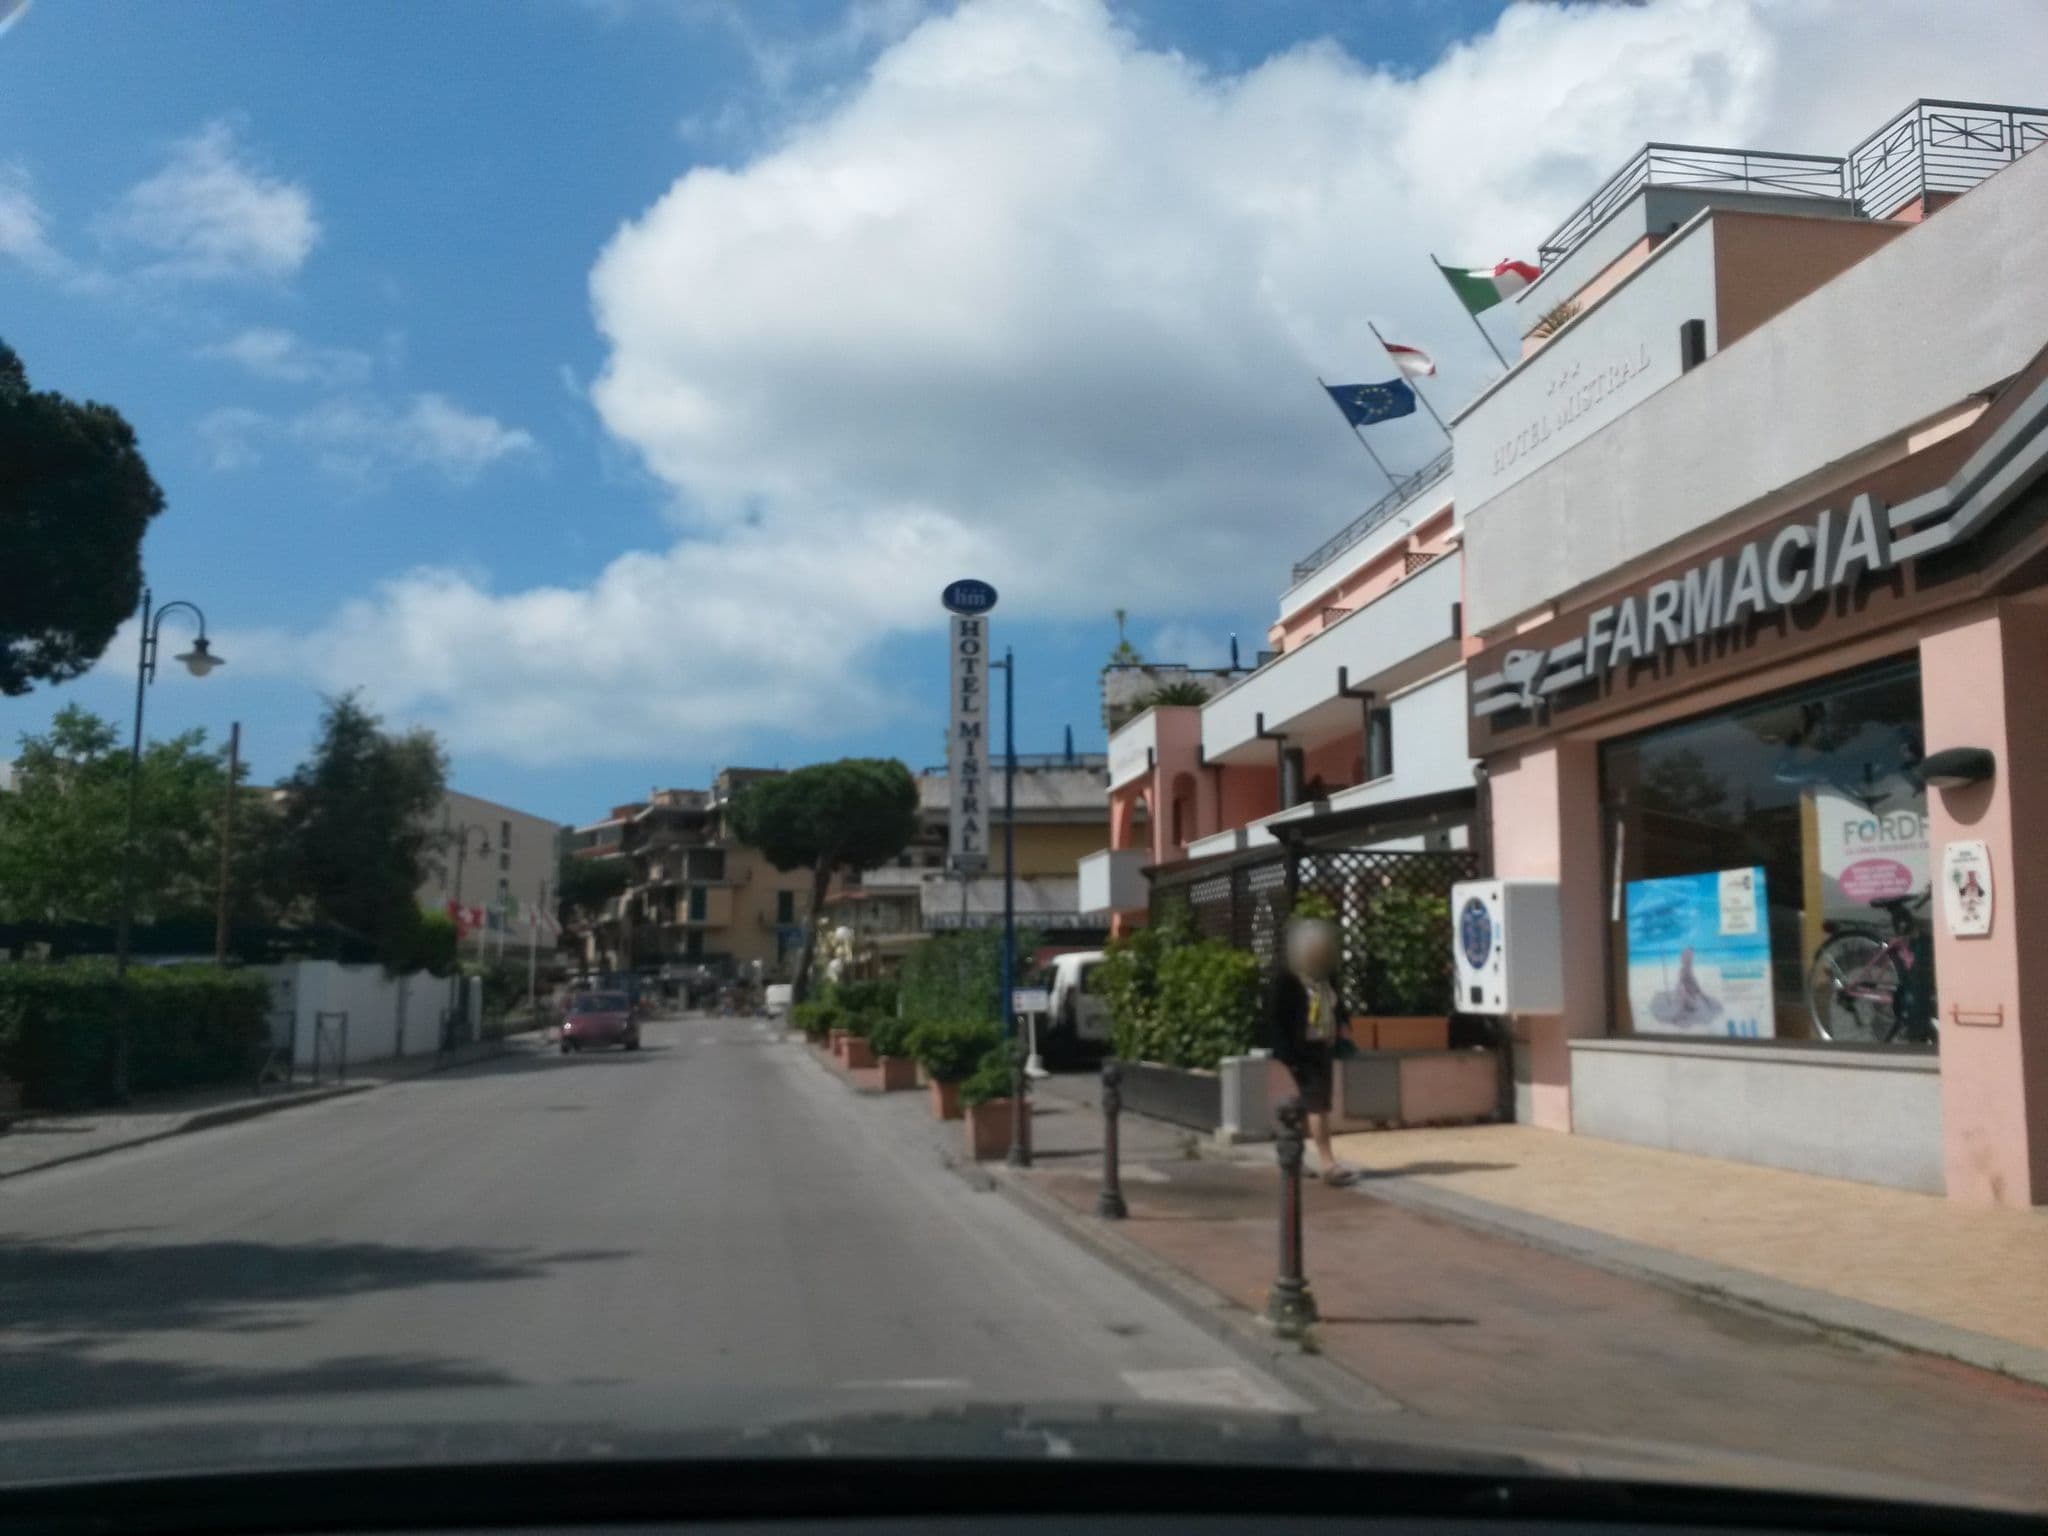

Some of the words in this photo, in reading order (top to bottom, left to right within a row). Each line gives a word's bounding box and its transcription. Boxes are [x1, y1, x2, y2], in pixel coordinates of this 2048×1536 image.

[1493, 415, 1552, 476] HOTEL
[1557, 343, 1652, 431] MISTRAL
[1585, 492, 1881, 676] FARMACIA
[960, 620, 980, 713] HOTEL
[959, 721, 981, 852] MISTRAL
